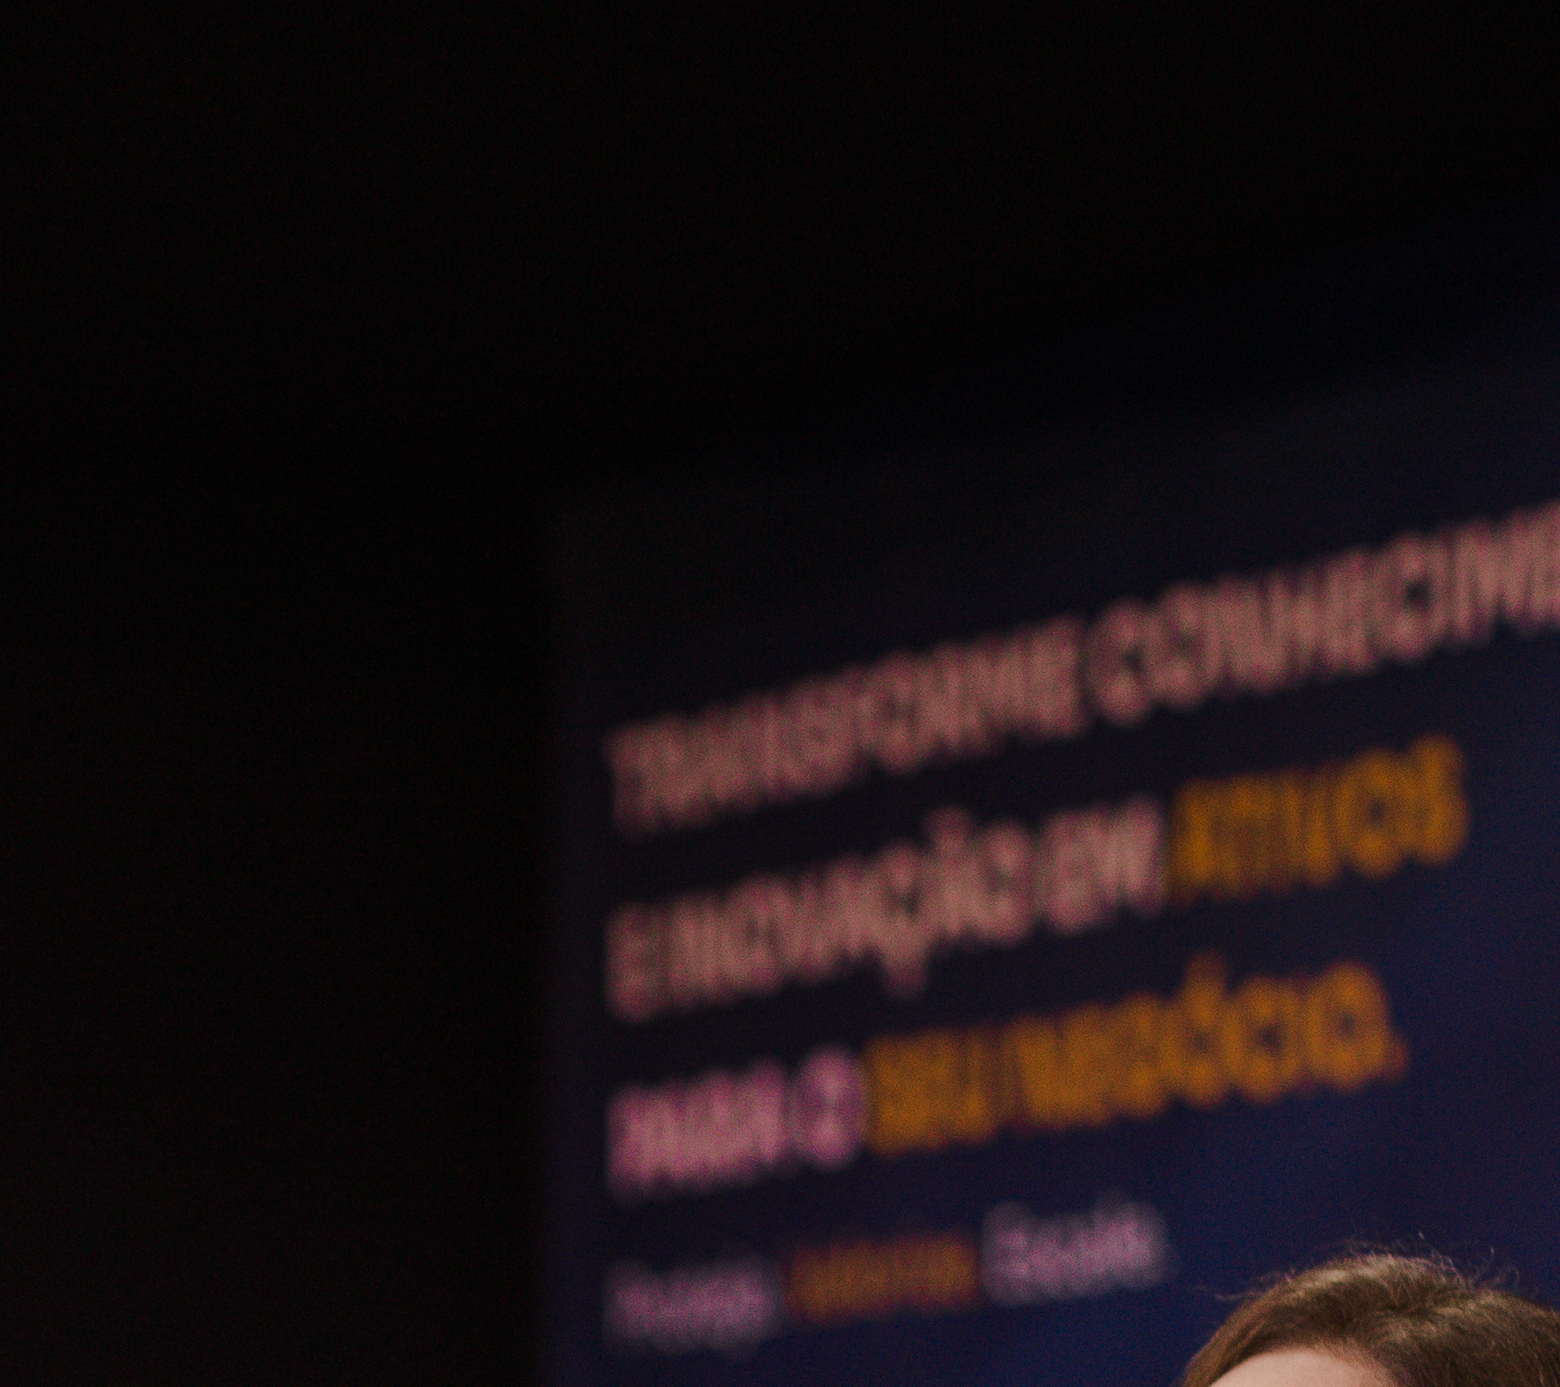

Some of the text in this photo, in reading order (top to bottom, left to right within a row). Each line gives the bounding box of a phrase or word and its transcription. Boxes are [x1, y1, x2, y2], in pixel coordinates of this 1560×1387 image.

[607, 612, 1084, 836] TRANSFORME
[658, 807, 1035, 1006] INOVAÇÃO
[1169, 735, 1468, 900] ATIVOS
[866, 1022, 994, 1158] SEU
